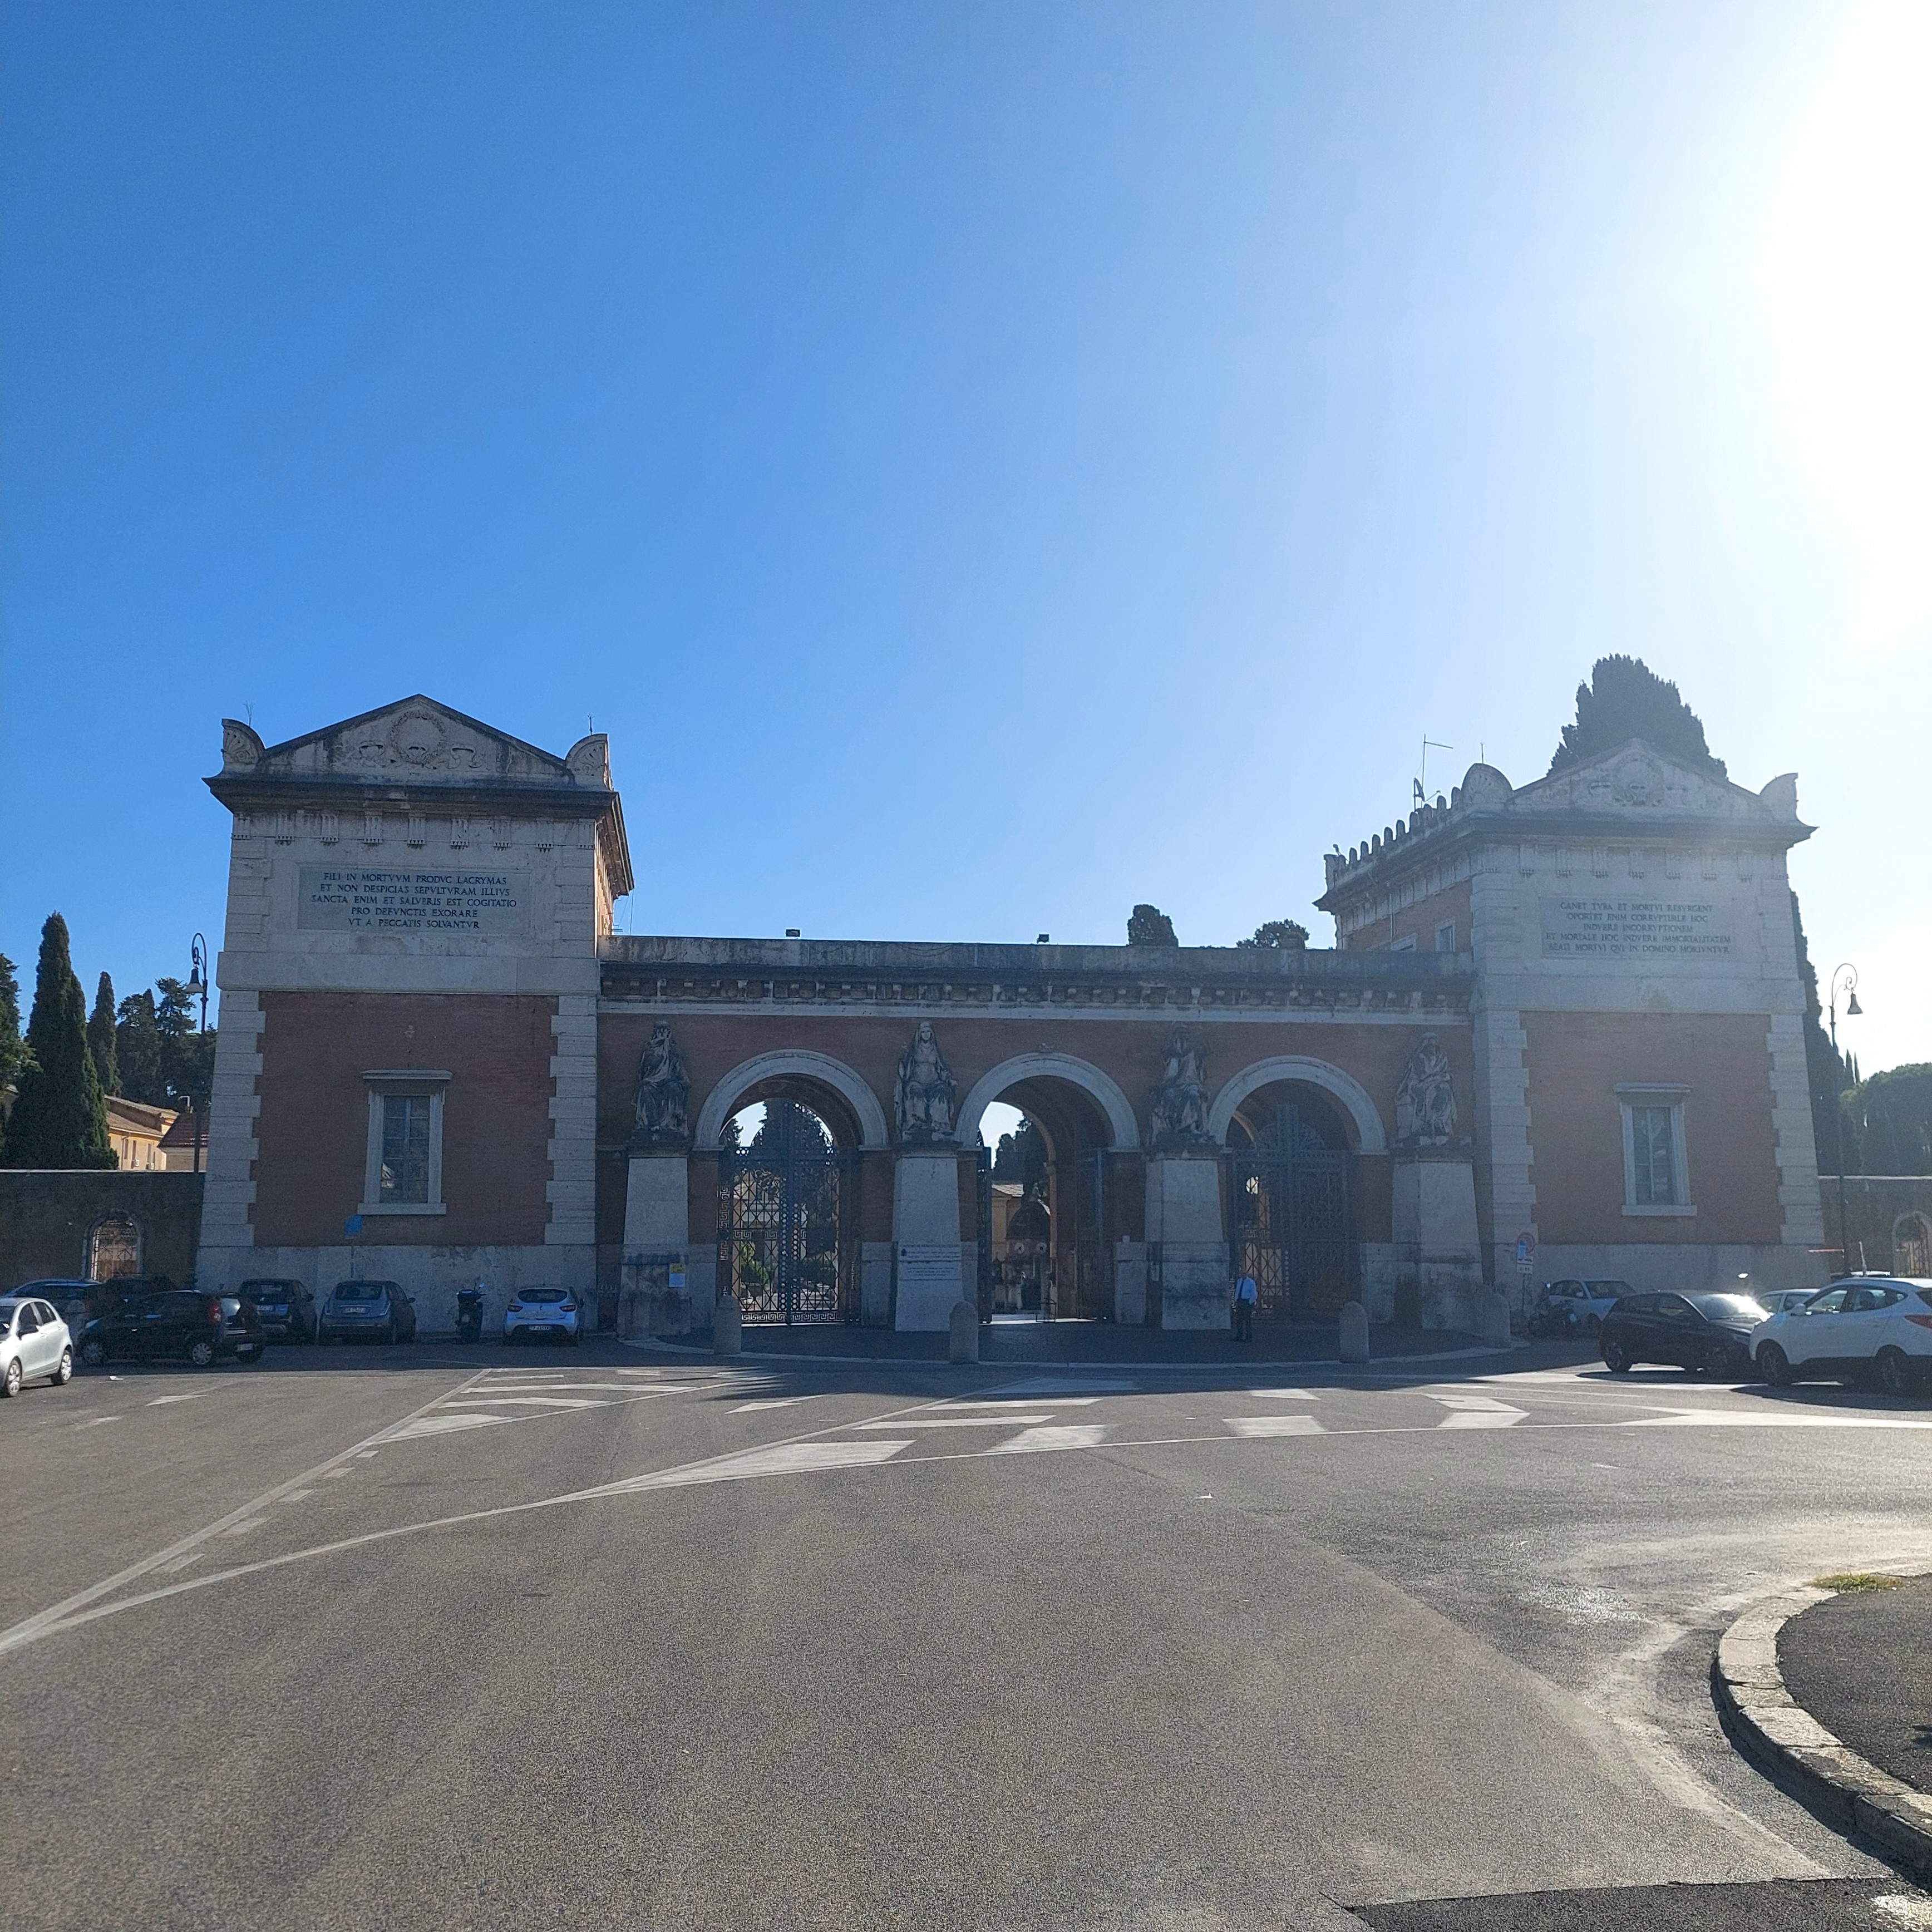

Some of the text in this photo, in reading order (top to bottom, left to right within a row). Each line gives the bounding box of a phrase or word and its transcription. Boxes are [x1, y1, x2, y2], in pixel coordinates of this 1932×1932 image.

[362, 874, 410, 882] MORTVVM
[457, 876, 506, 884] LACRYMAS
[364, 885, 409, 893] DESPICIAS
[415, 886, 476, 895] SEPVLTVRAM
[376, 908, 426, 916] DEFVNCTIS
[1610, 944, 1624, 954] QVI
